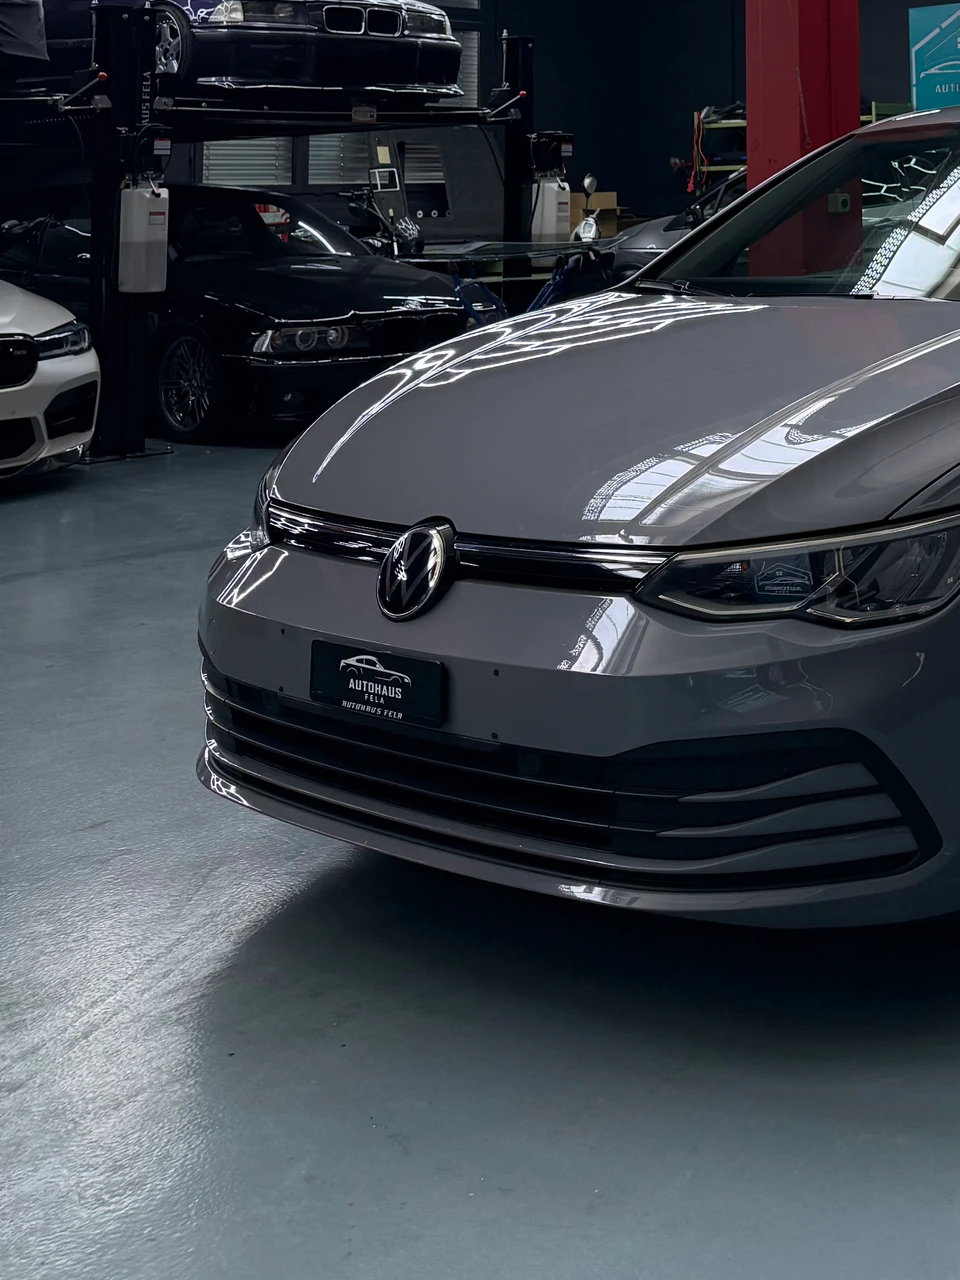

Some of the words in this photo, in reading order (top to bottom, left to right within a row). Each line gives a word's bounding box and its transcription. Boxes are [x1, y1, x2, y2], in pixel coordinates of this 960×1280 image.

[142, 71, 151, 99] FELA
[348, 678, 402, 699] AUTOHAUS
[364, 693, 385, 705] FELA
[341, 699, 382, 715] AUTOHAUS
[383, 709, 403, 720] FELA
